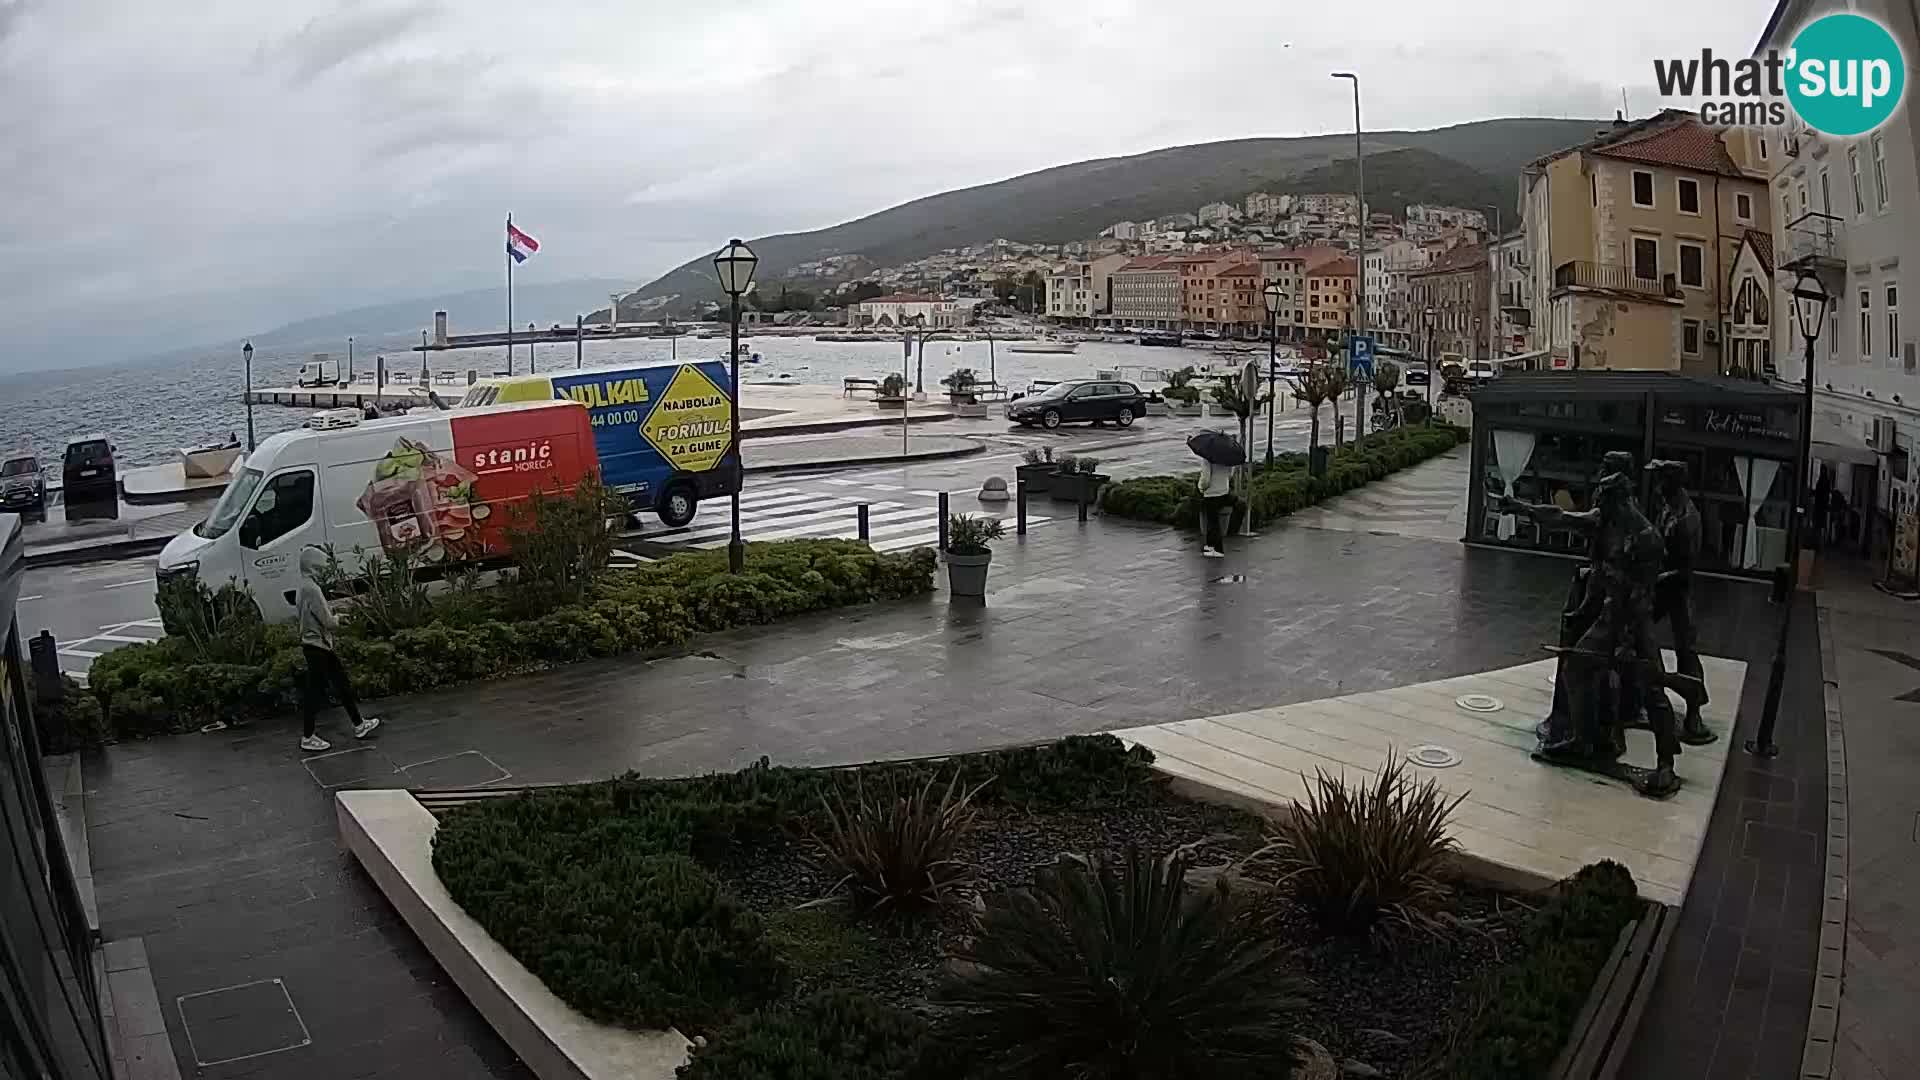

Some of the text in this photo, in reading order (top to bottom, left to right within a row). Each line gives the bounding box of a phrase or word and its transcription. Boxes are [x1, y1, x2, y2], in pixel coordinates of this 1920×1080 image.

[1355, 340, 1367, 356] P
[663, 396, 721, 411] NAJBOLJA
[607, 411, 622, 425] 00
[624, 410, 638, 423] 00
[656, 418, 731, 442] FORMULA
[475, 440, 551, 468] stanić
[671, 440, 722, 456] ZA GUME
[514, 459, 553, 472] HORECA
